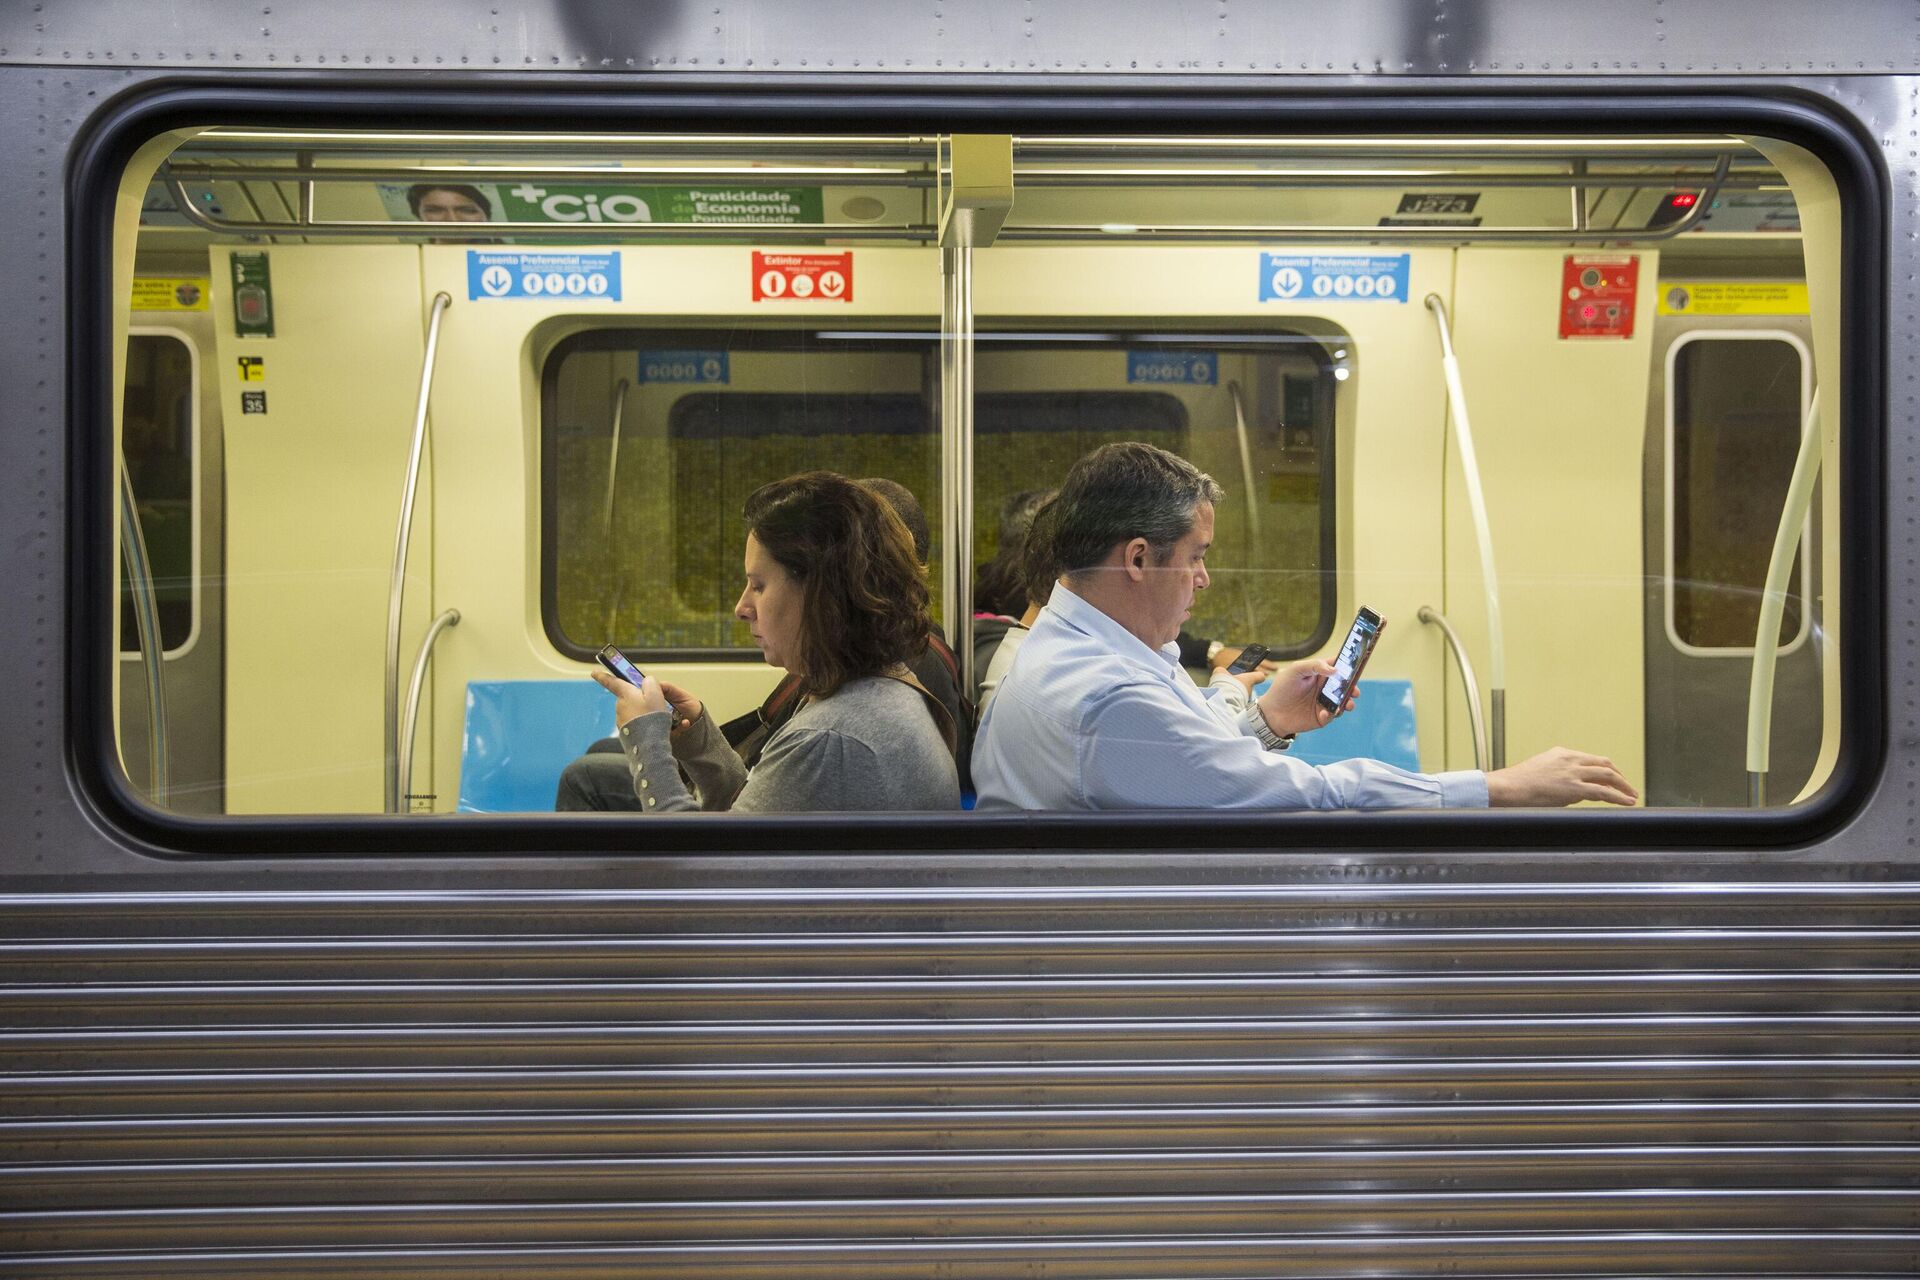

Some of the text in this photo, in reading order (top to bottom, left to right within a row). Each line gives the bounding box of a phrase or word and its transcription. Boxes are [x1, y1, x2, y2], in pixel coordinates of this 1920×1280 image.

[690, 191, 791, 202] Praticidade
[696, 202, 800, 214] Economia
[1405, 199, 1468, 212] J273
[479, 255, 519, 265] Assento
[520, 254, 580, 265] Preferencial
[764, 256, 803, 266] Extintor
[1271, 257, 1310, 267] Assento
[246, 400, 263, 411] 35
